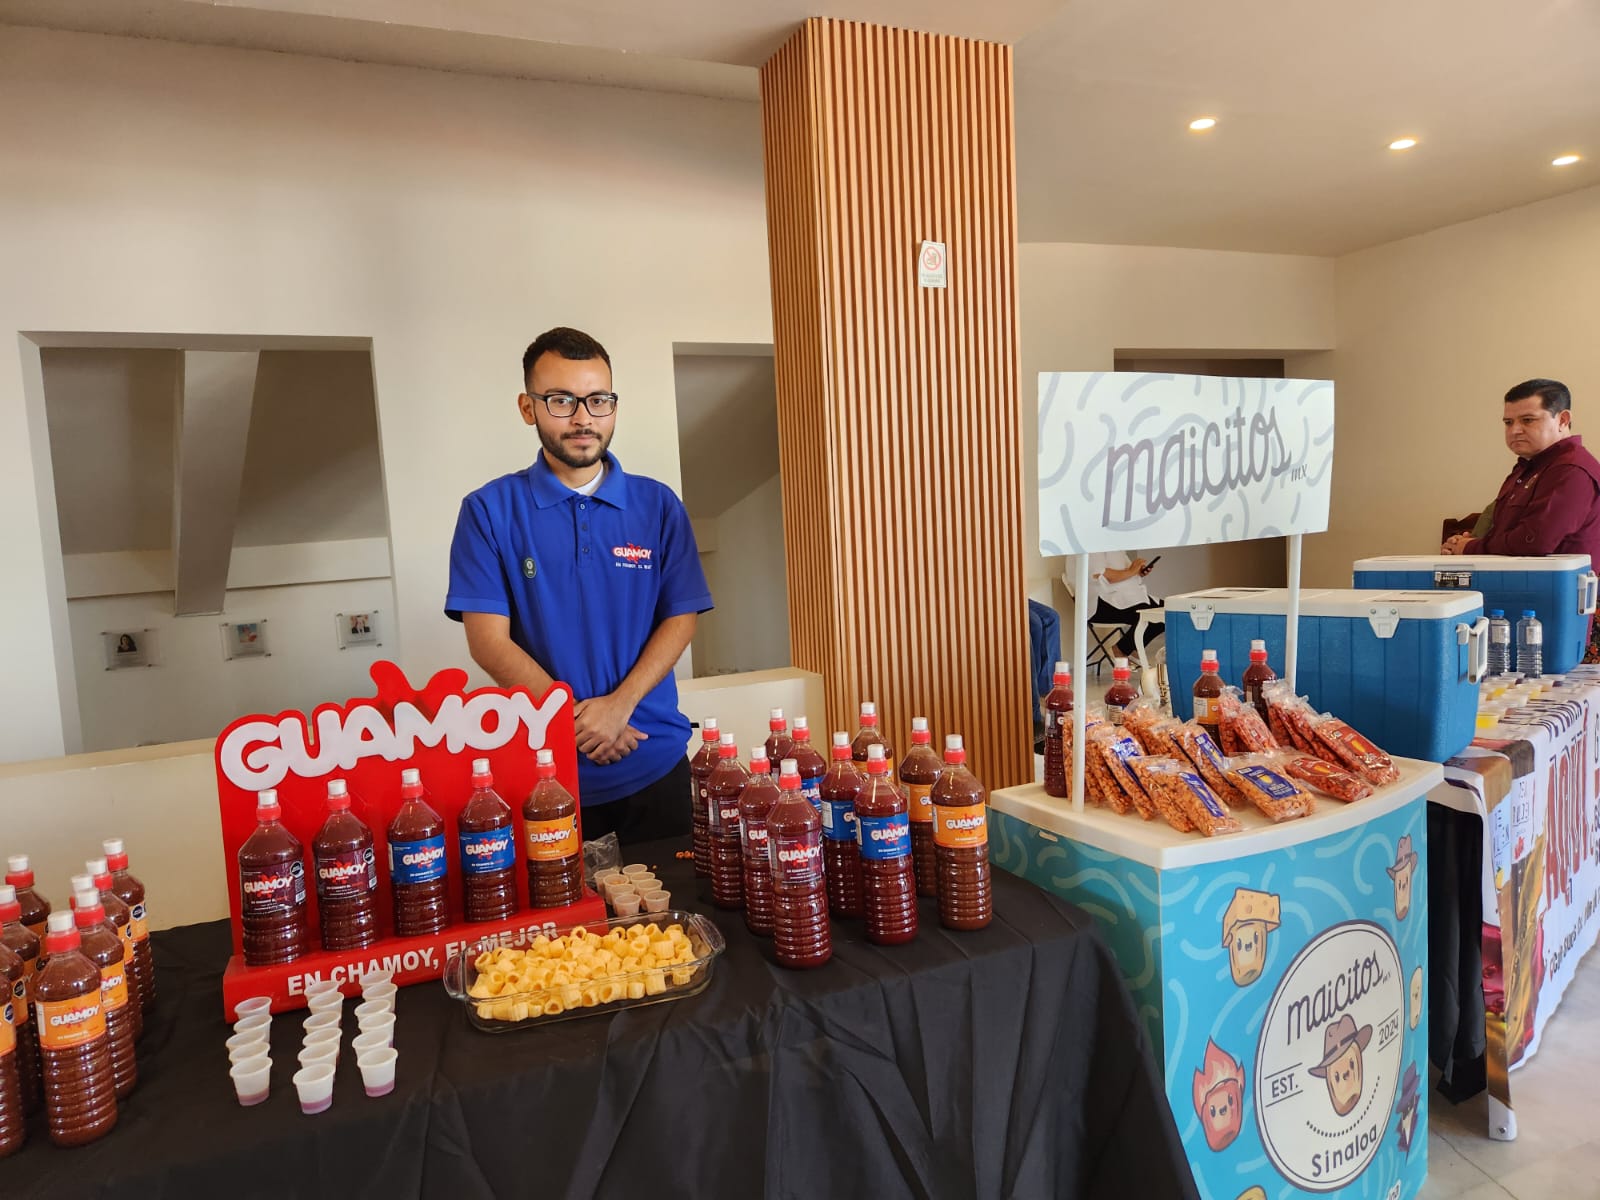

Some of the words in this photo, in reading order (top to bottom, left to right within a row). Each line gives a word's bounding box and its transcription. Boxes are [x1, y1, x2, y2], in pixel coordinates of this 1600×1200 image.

[1101, 405, 1292, 528] maicitos
[1290, 463, 1308, 482] mx
[613, 546, 652, 559] GUAMOY
[220, 688, 569, 791] GUAMOY
[801, 788, 820, 798] GUA
[721, 808, 739, 819] GUA
[946, 816, 985, 829] GUAMOY
[530, 829, 572, 843] GUAMOY
[748, 829, 768, 840] GUA
[871, 824, 910, 841] GUAMOY
[402, 846, 445, 865] GUAMOY
[465, 839, 508, 855] GUAMOY
[779, 846, 821, 862] GUAMOY
[319, 862, 367, 879] GUAMOY
[243, 876, 293, 893] GUAMOY
[287, 969, 322, 996] EN
[330, 946, 439, 986] CHAMOY,
[480, 921, 560, 952] MEJOR
[1286, 949, 1384, 1046] maicitos
[50, 1005, 100, 1027] GUAMOY
[1378, 1015, 1399, 1046] 2024
[1271, 1072, 1299, 1099] EST.
[1311, 1123, 1378, 1178] Sinaloa
